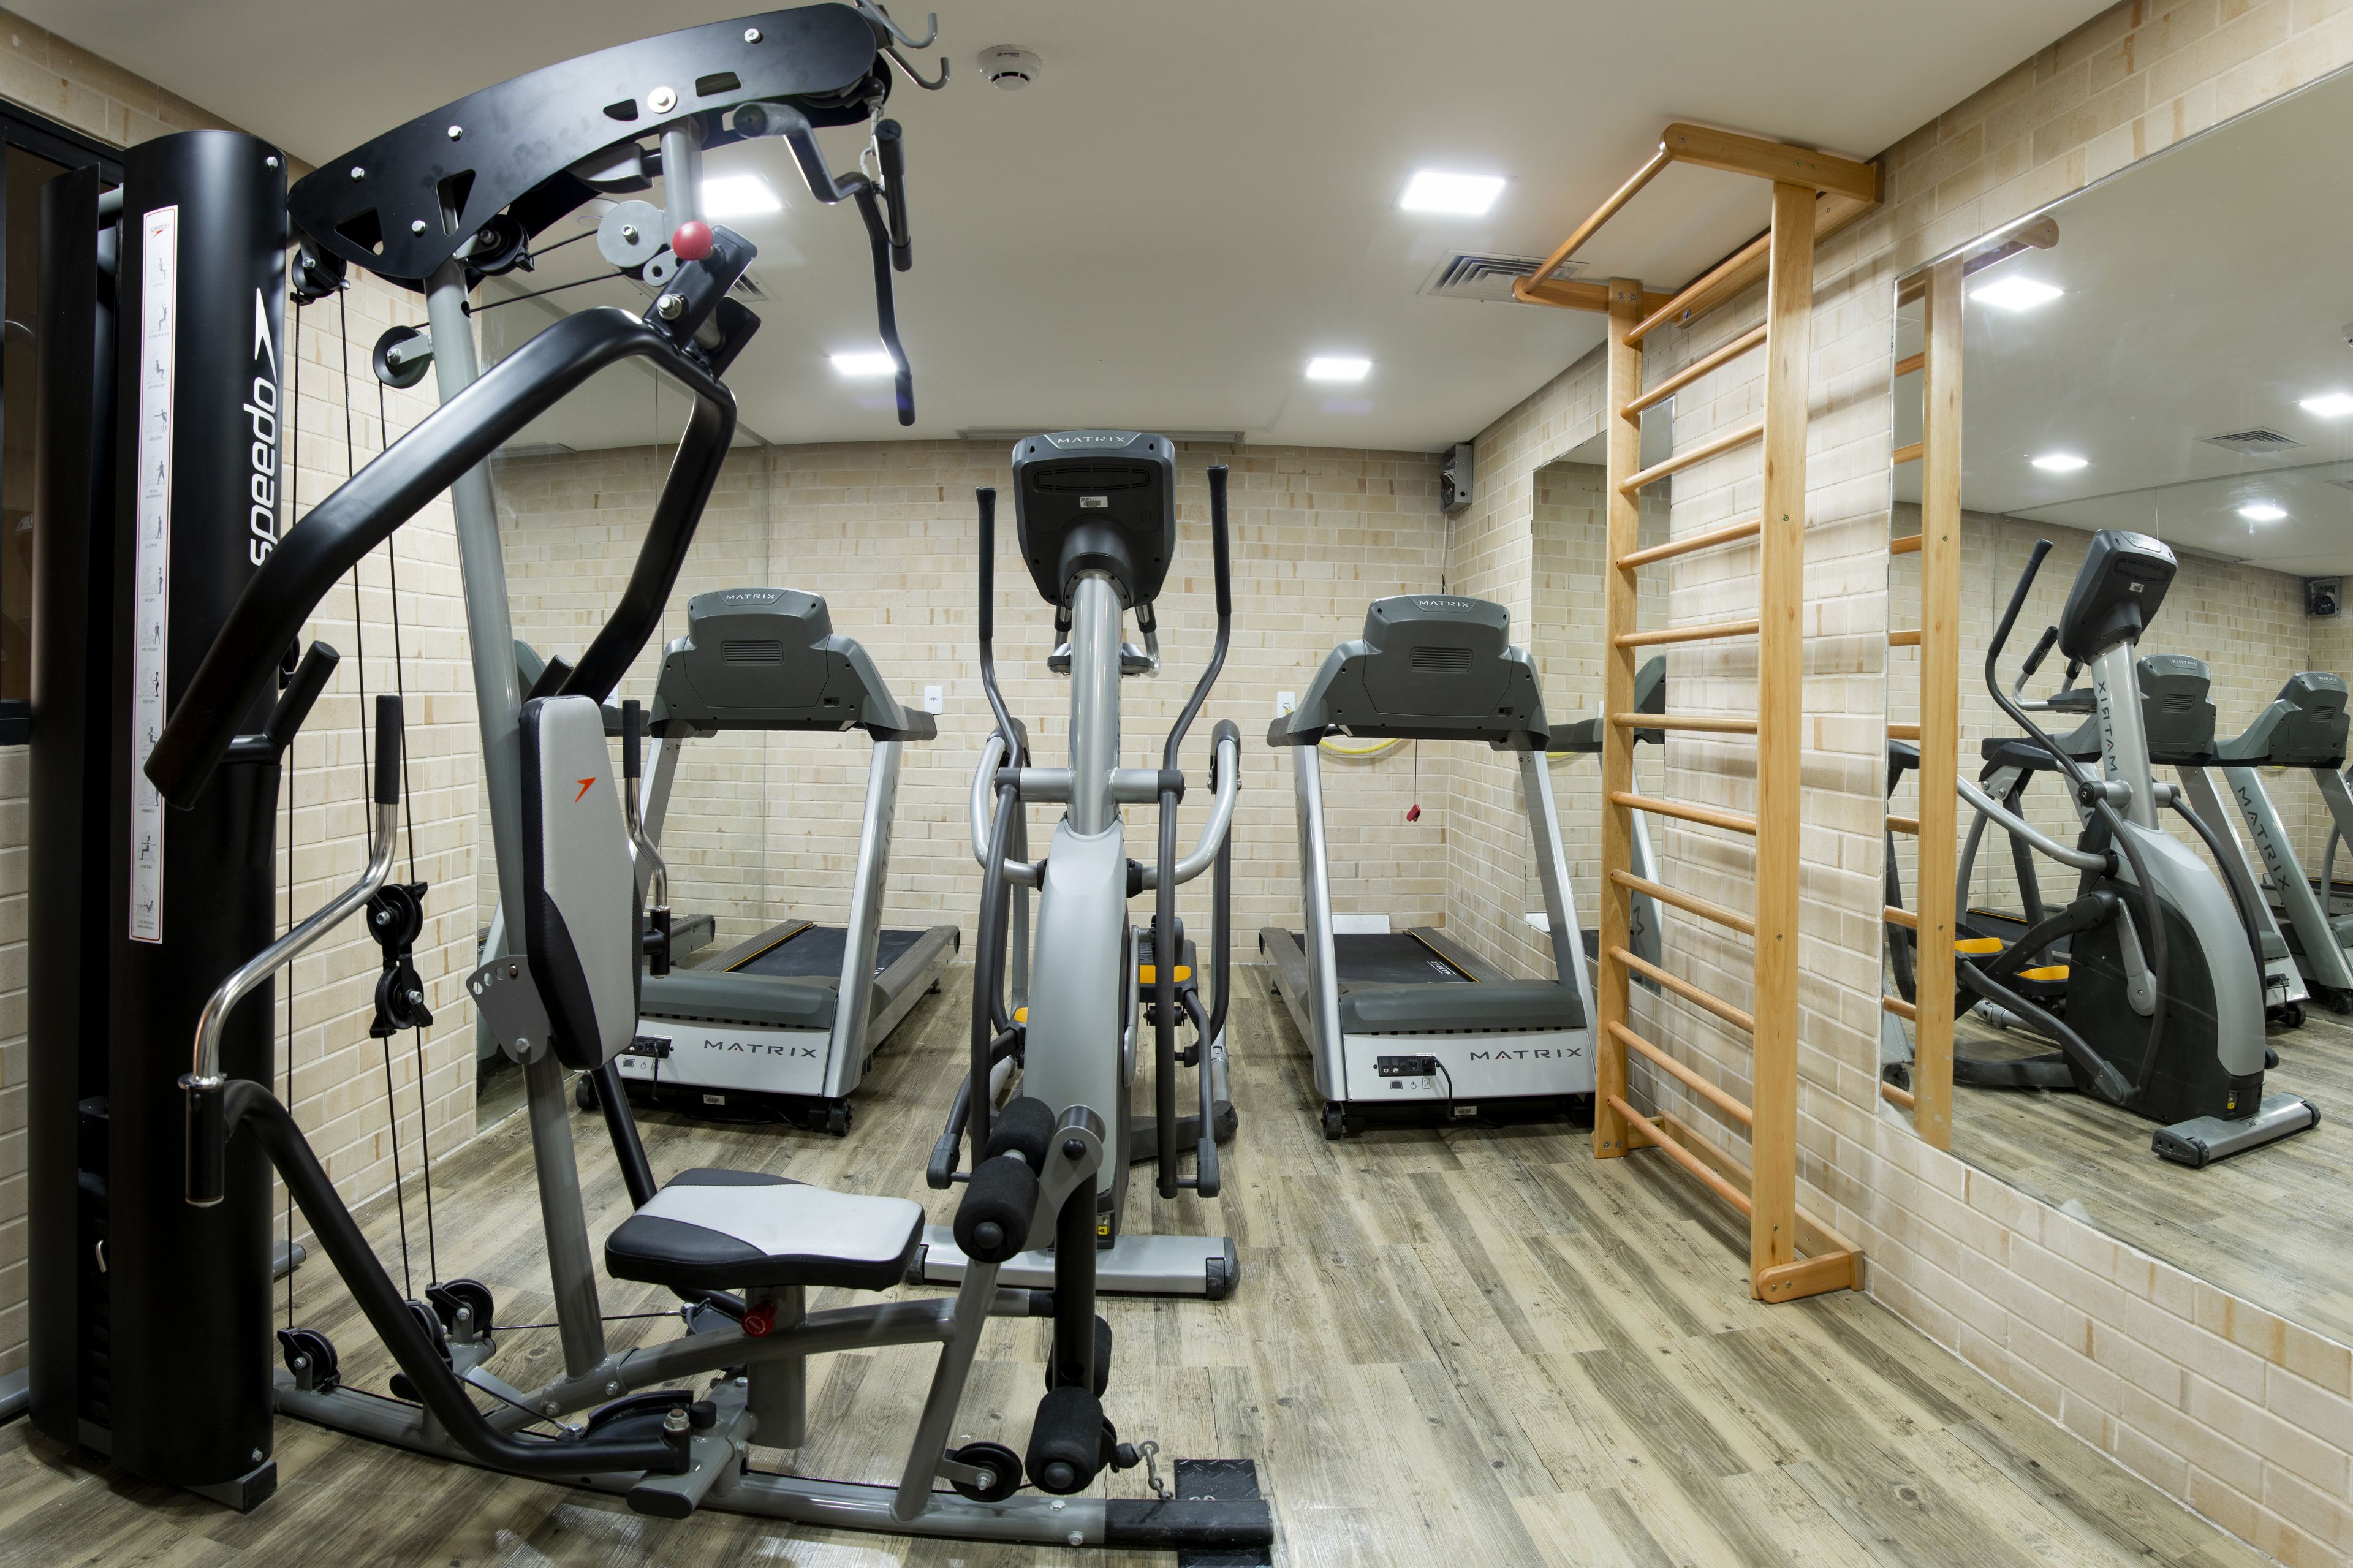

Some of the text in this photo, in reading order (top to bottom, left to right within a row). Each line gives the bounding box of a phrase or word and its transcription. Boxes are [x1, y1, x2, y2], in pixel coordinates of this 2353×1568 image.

[243, 376, 279, 567] speedo
[873, 776, 897, 939] MATRIX
[2238, 786, 2290, 892] MATRIX
[704, 1040, 817, 1058] MATRIX
[1470, 1048, 1582, 1061] MATRIX
